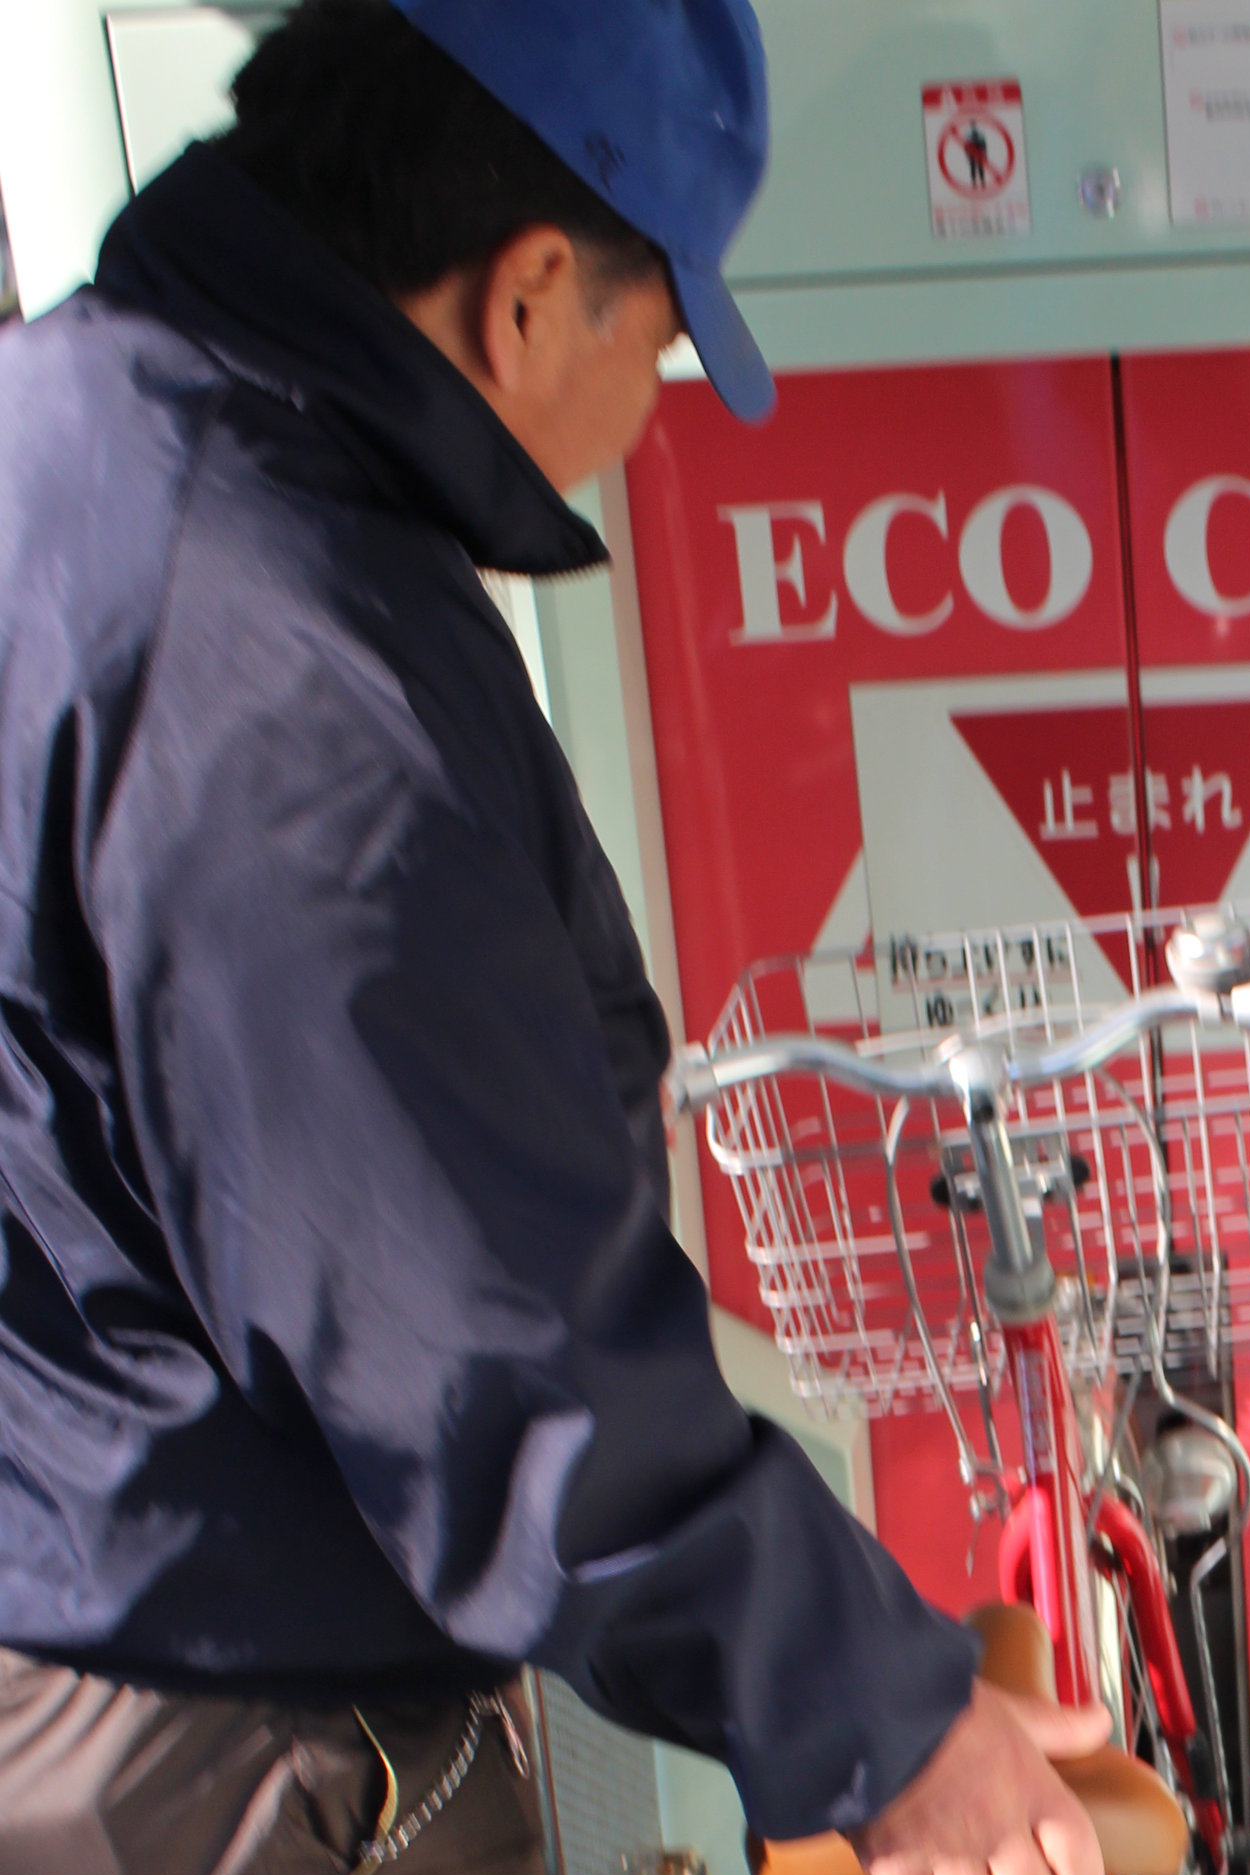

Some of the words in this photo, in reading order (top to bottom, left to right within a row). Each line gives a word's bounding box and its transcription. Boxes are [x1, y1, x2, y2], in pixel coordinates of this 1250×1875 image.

[717, 484, 1093, 646] ECO
[1039, 765, 1243, 842] 止まれ
